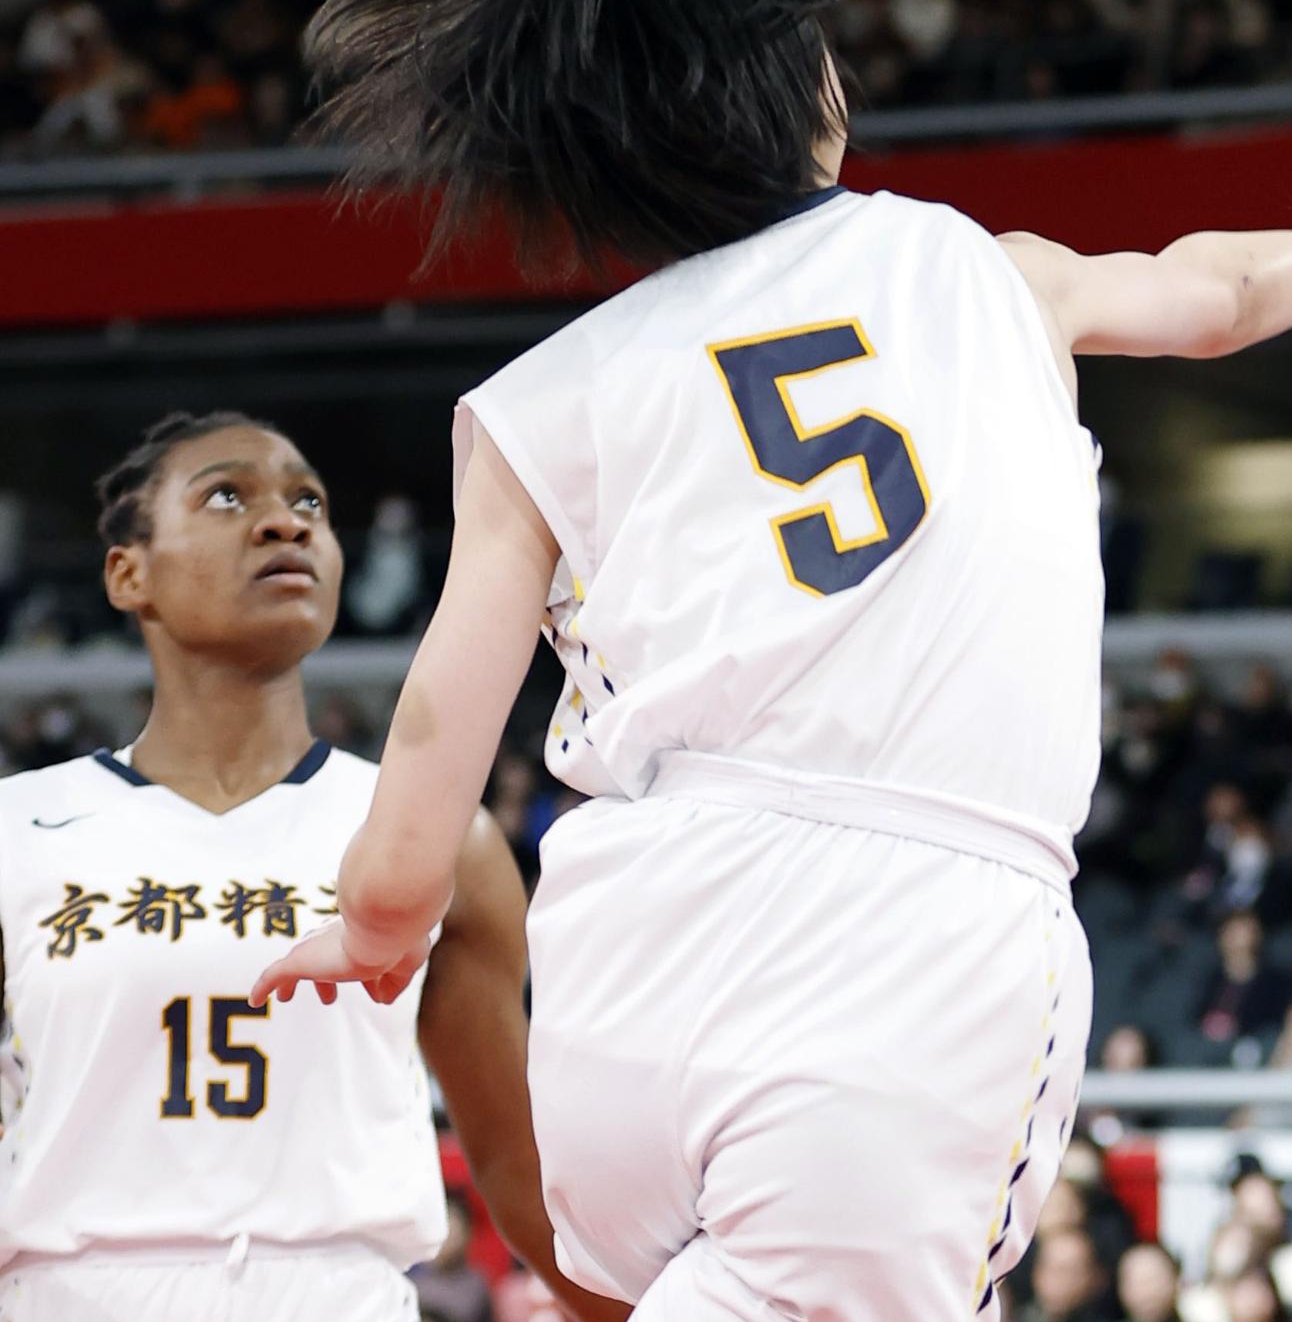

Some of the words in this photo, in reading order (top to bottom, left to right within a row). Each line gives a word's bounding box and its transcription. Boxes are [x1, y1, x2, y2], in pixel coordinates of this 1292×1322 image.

[706, 317, 932, 598] 5
[38, 877, 338, 960] 京都精
[159, 995, 272, 1119] 15
